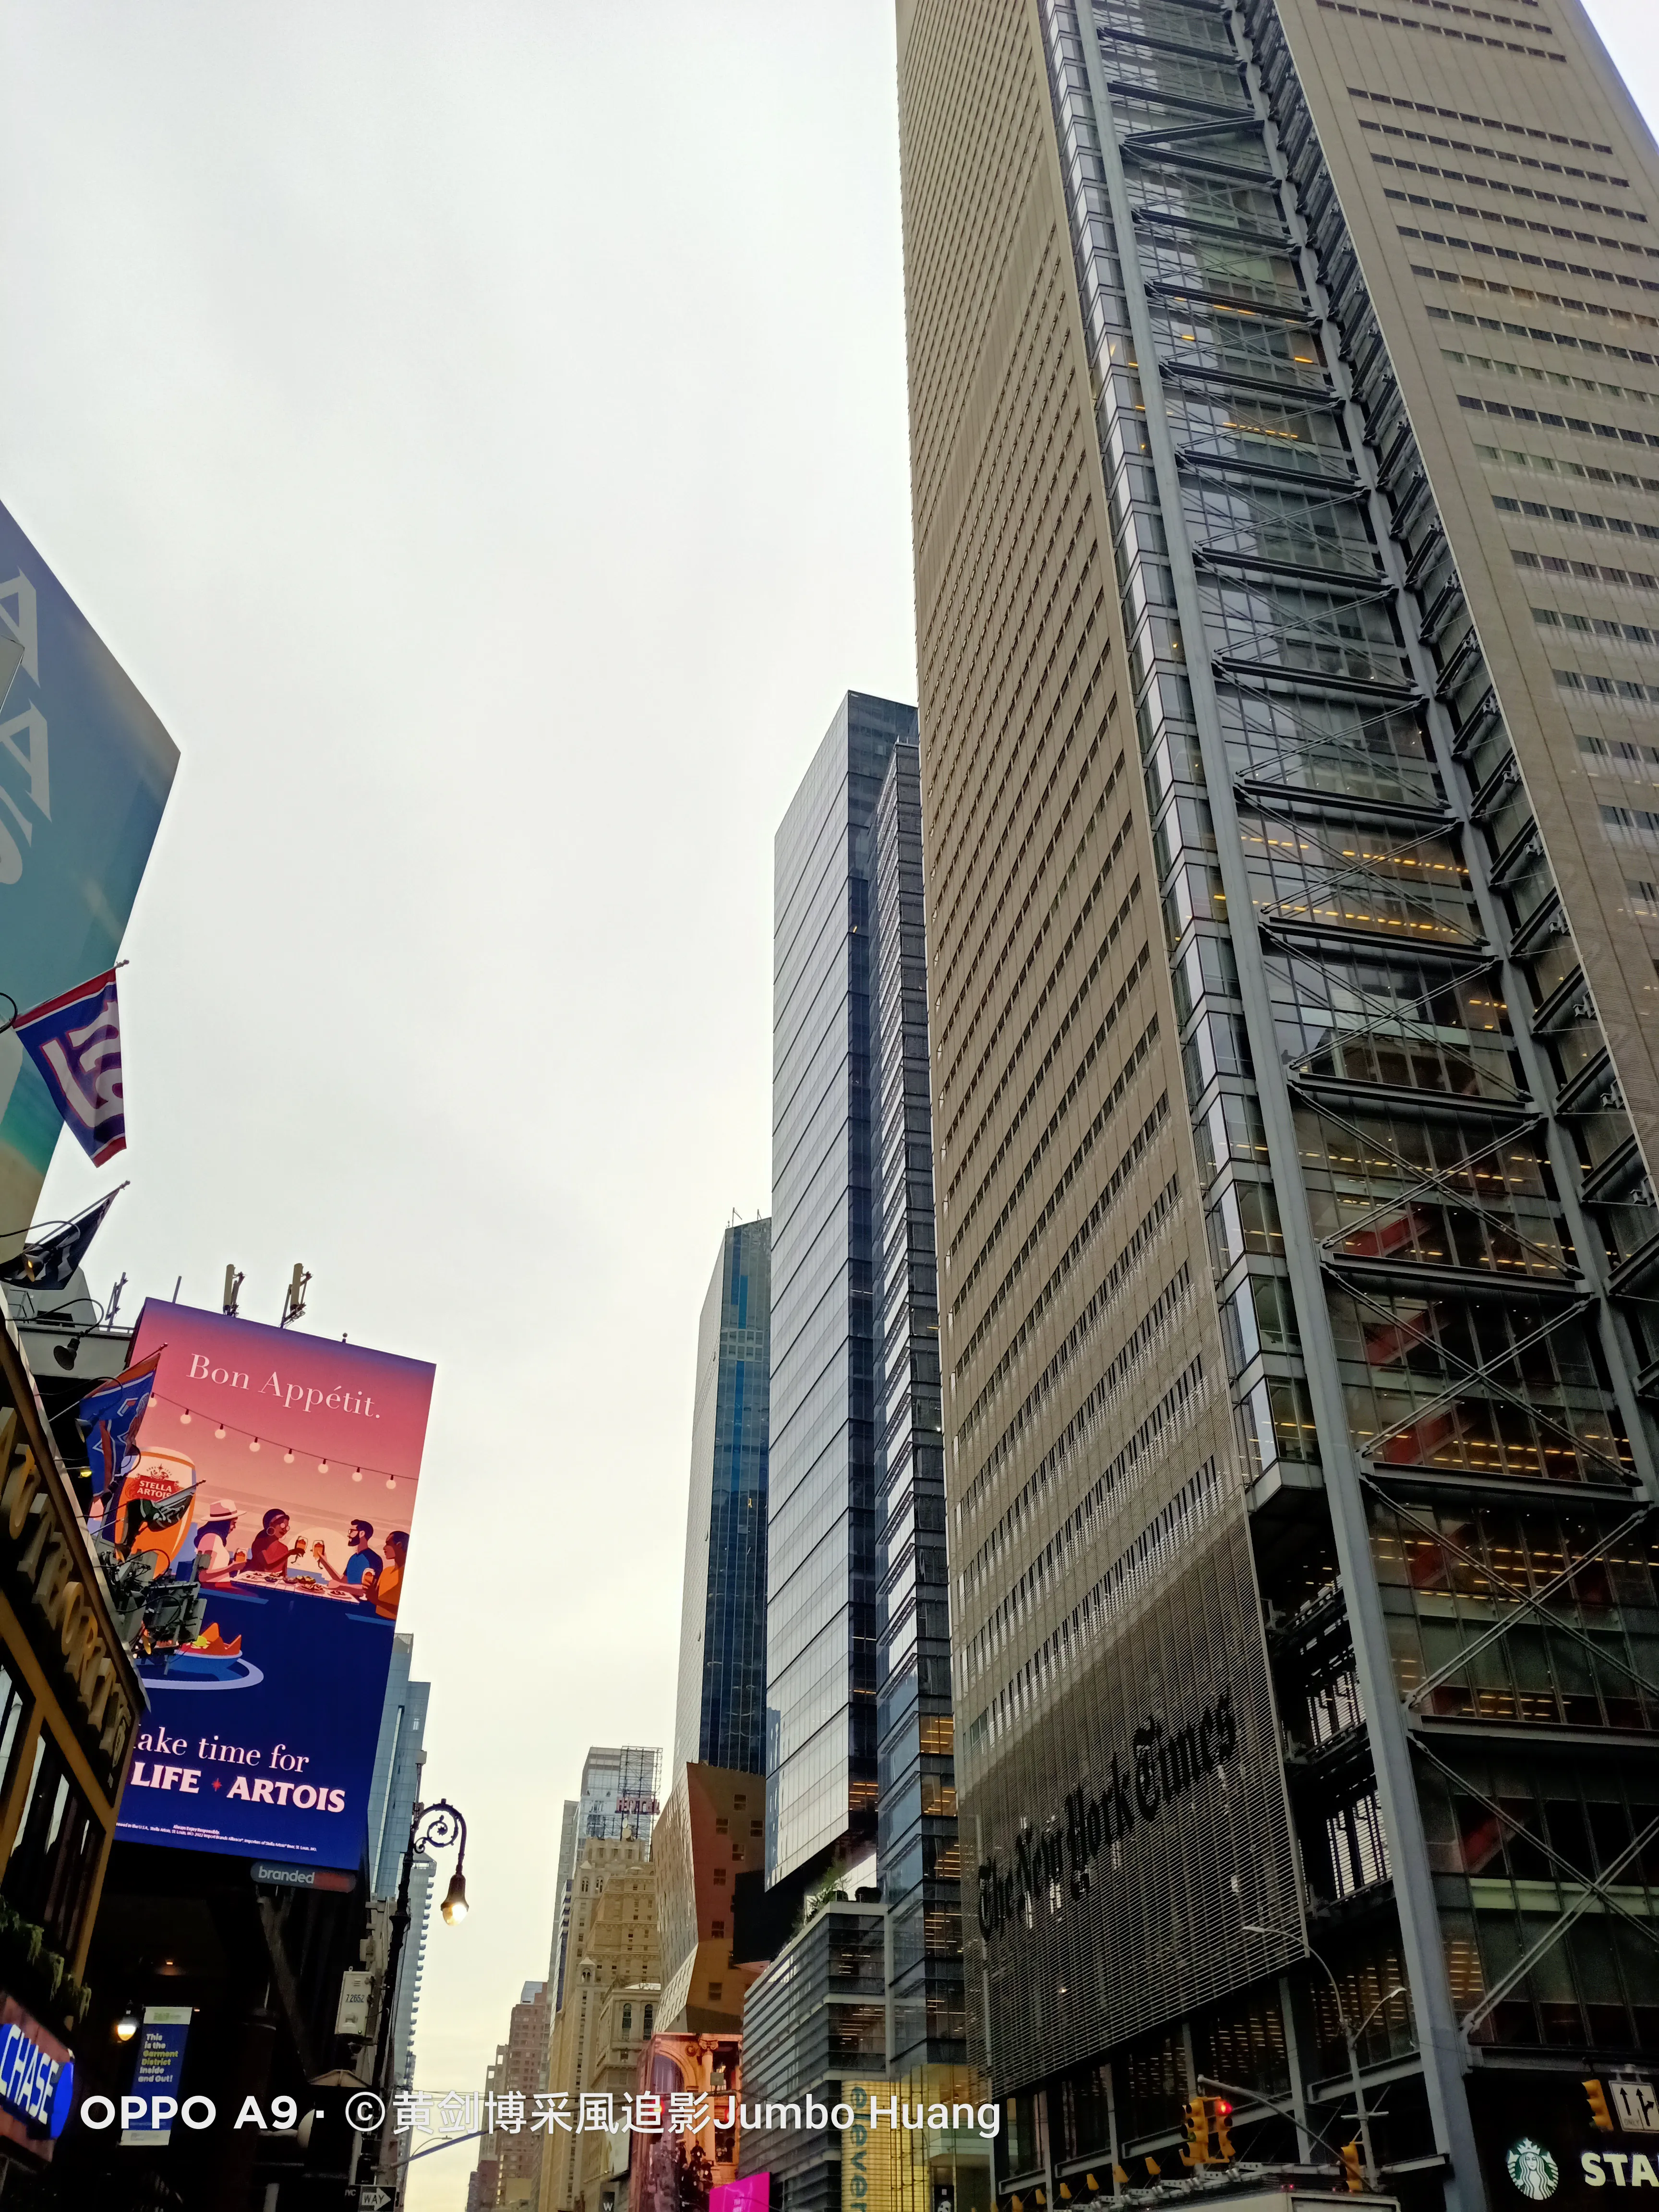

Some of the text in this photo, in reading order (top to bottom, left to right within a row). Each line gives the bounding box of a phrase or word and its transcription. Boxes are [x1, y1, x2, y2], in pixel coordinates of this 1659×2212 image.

[186, 1353, 381, 1419] Bon Appétit.
[139, 1480, 172, 1492] STELLA
[133, 1724, 188, 1755] ake
[198, 1735, 261, 1767] time
[268, 1743, 309, 1773] for
[131, 1761, 346, 1813] LIFE ARTOIS
[616, 1796, 661, 1813] HOTEL
[978, 1684, 1237, 1940] The New York Times
[258, 1866, 315, 1884] branded
[346, 1994, 365, 2003] 72652
[0, 2024, 59, 2125] CHASE
[140, 2066, 164, 2074] Inside
[1582, 2152, 1659, 2188] STA
[363, 2195, 385, 2205] WAY
